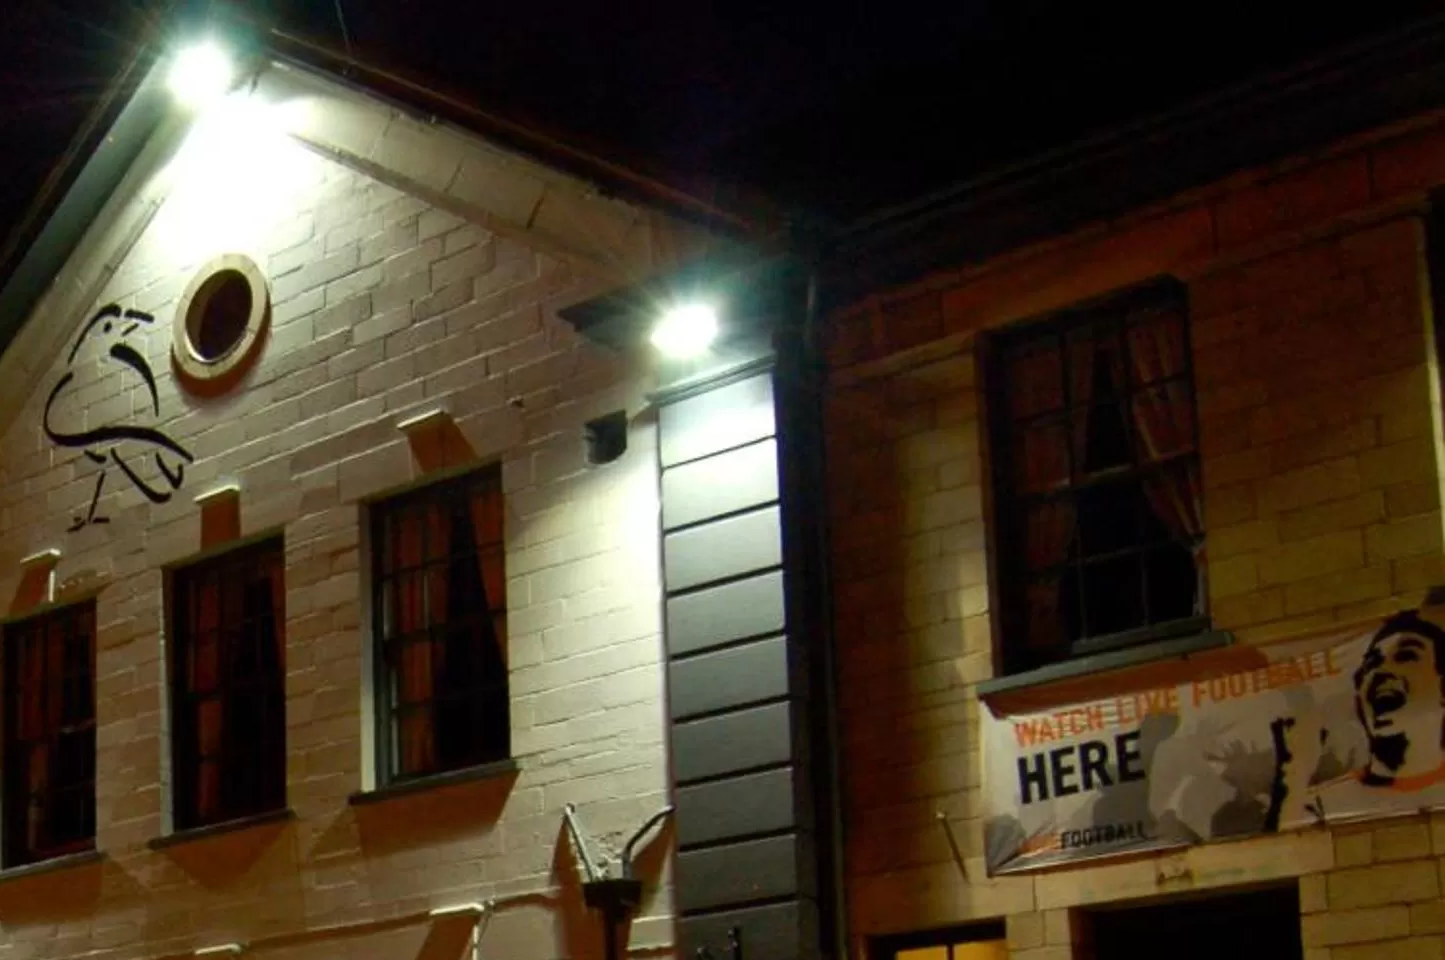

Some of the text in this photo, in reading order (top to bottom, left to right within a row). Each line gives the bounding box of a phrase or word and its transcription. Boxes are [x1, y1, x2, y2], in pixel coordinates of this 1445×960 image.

[1013, 650, 1341, 747] WATCH LIVE FOOTBALL
[1017, 731, 1145, 805] HERE
